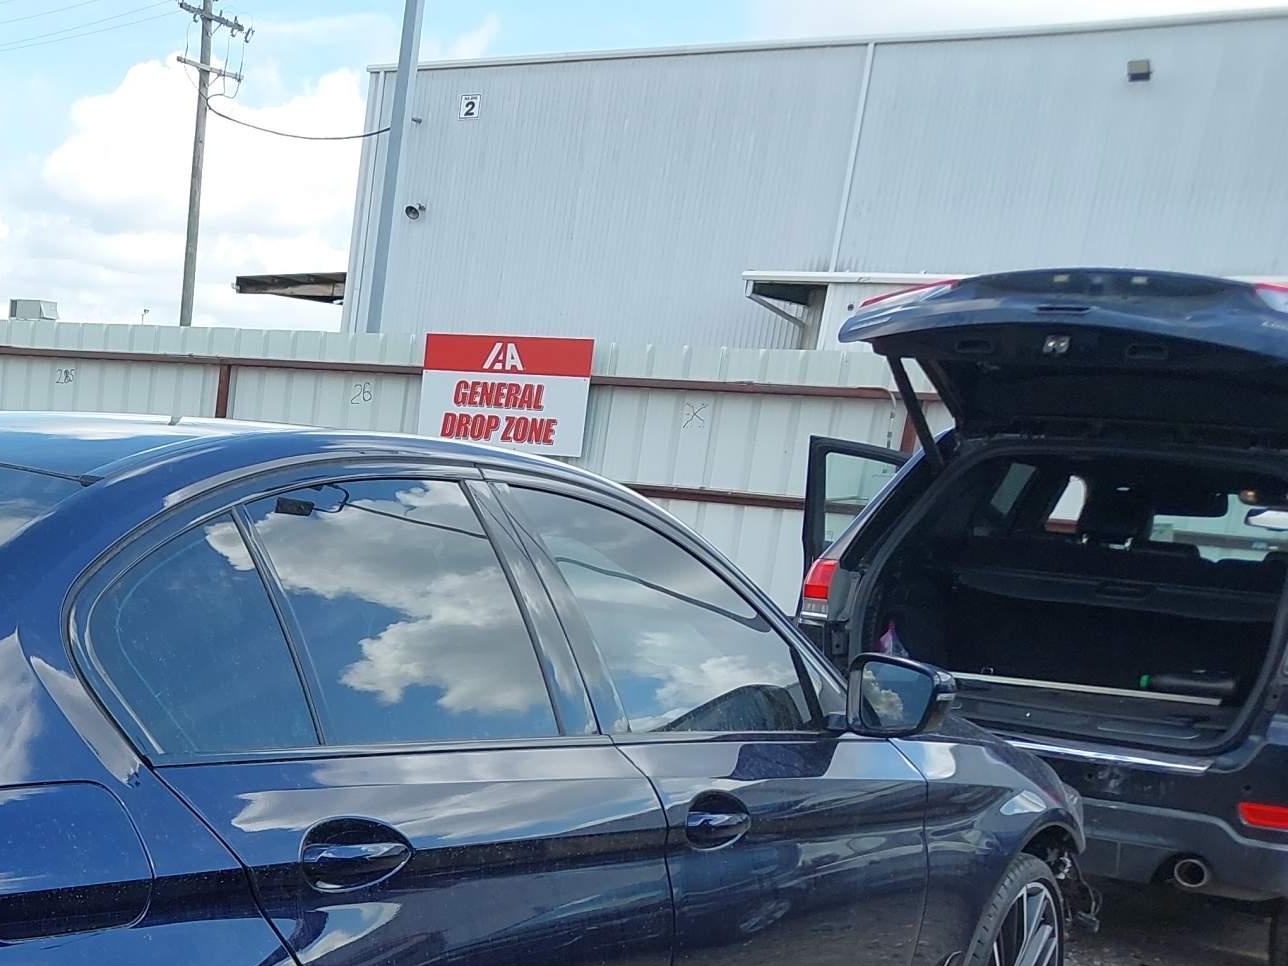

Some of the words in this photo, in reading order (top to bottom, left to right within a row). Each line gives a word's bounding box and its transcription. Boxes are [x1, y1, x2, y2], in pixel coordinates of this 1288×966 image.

[464, 101, 475, 117] 2
[350, 382, 373, 405] 26
[453, 380, 545, 411] GENERAL
[440, 412, 500, 441] DROP
[500, 415, 558, 445] ZONE
